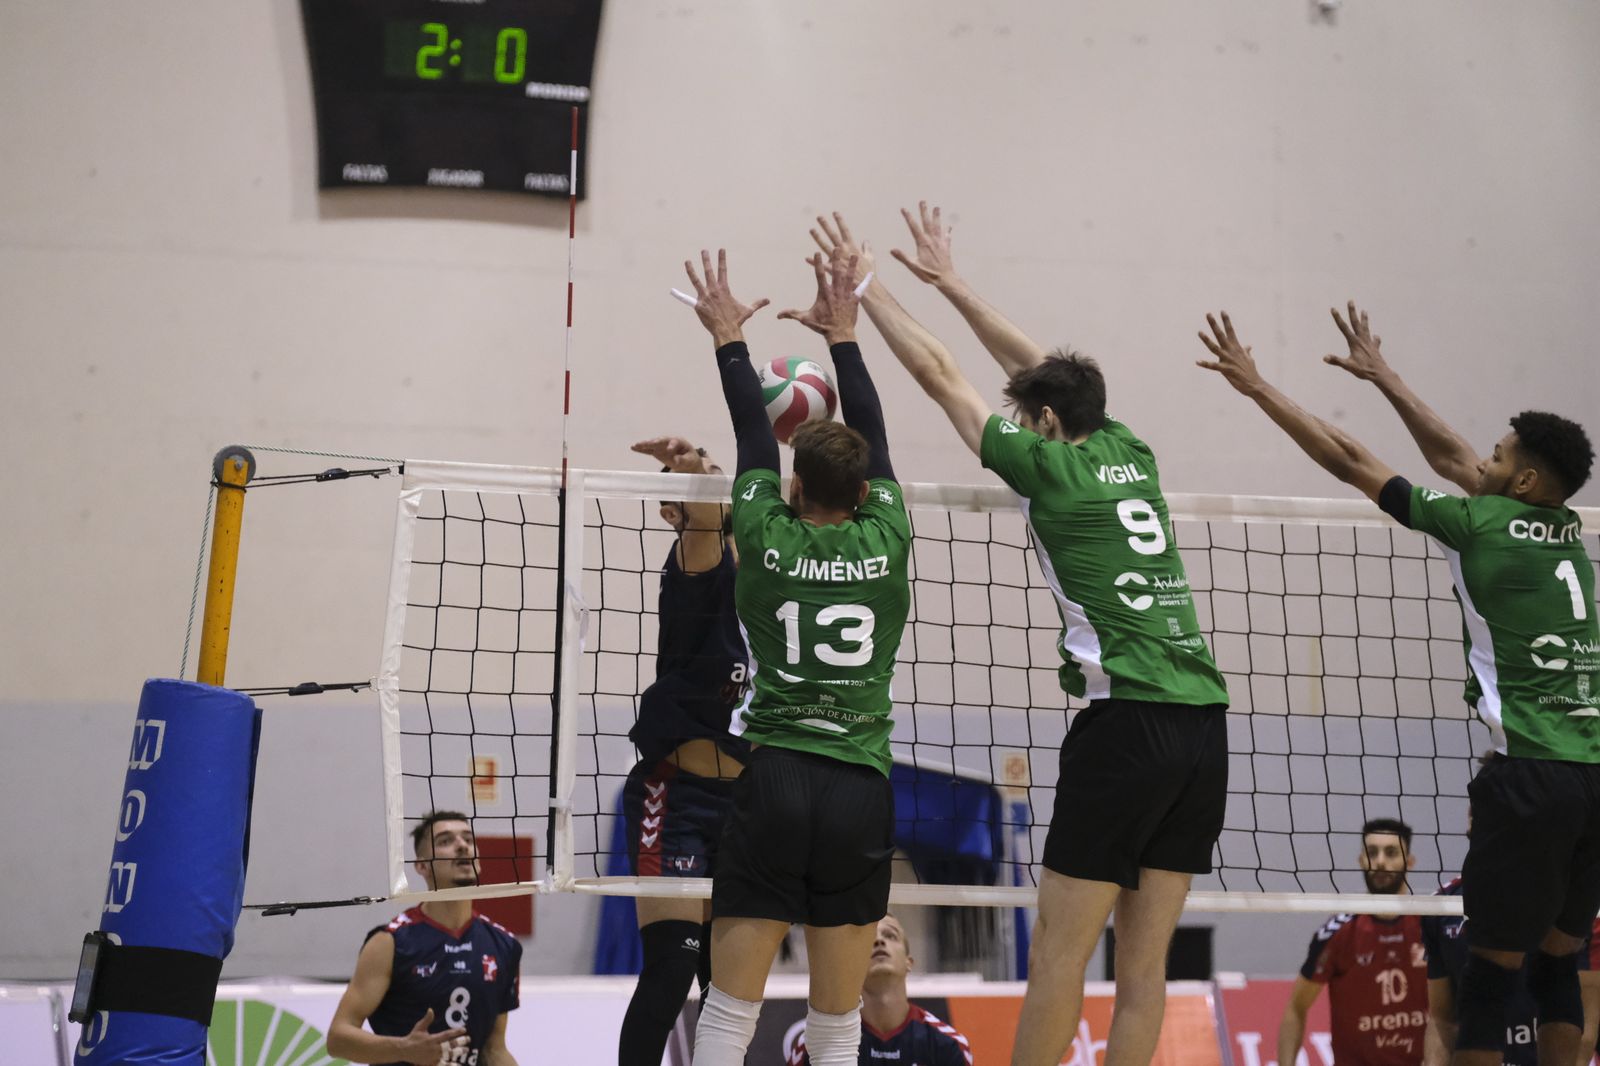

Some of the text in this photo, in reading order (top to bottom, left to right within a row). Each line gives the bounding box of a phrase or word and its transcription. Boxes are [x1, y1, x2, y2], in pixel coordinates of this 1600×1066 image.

[494, 27, 528, 84] 0
[1095, 462, 1149, 485] VIGIL
[1116, 498, 1167, 556] 9
[763, 548, 891, 582] C. JIMÉNEZ
[1554, 559, 1588, 620] 1
[775, 600, 876, 667] 13
[827, 709, 841, 719] DE
[444, 986, 471, 1031] 8
[1375, 967, 1409, 1006] 10
